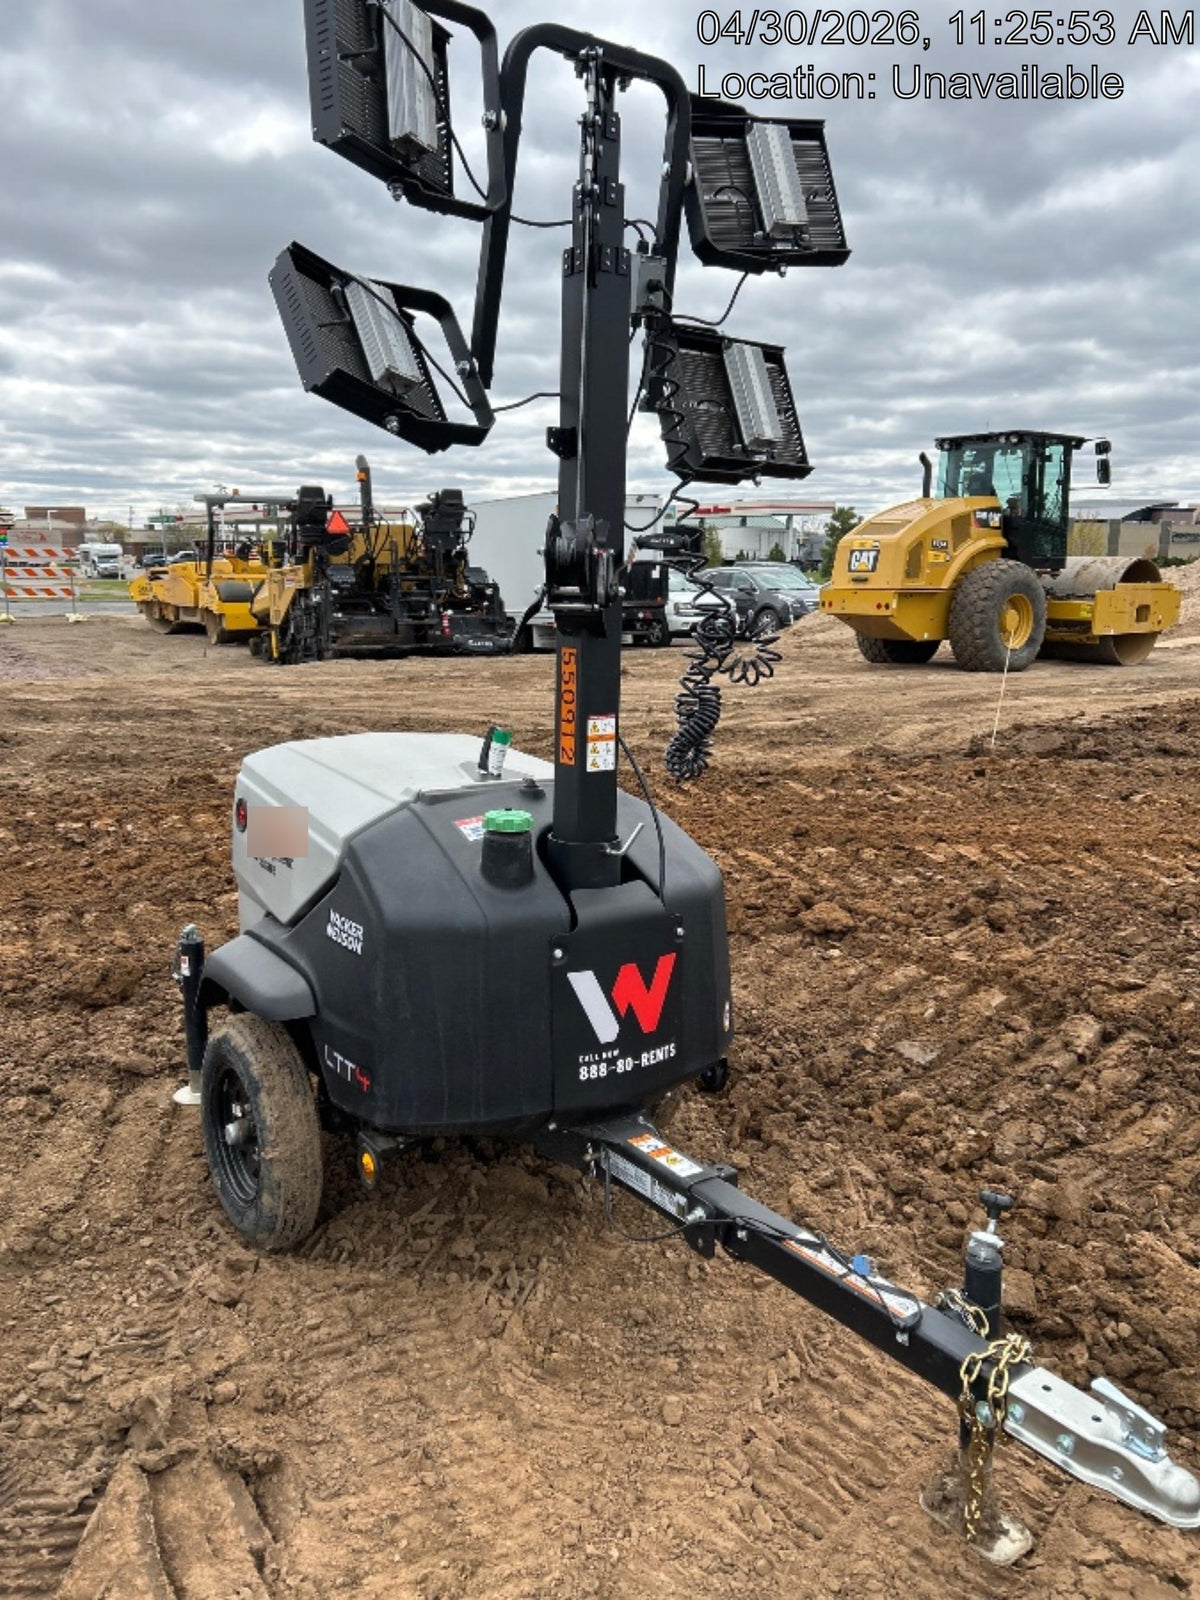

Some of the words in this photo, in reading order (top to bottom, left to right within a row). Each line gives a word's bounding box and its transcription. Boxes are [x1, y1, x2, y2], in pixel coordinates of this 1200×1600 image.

[850, 550, 878, 571] CAT
[561, 651, 575, 761] 550912
[324, 1044, 370, 1092] LTT4
[579, 1043, 676, 1081] 888-80-RENTS
